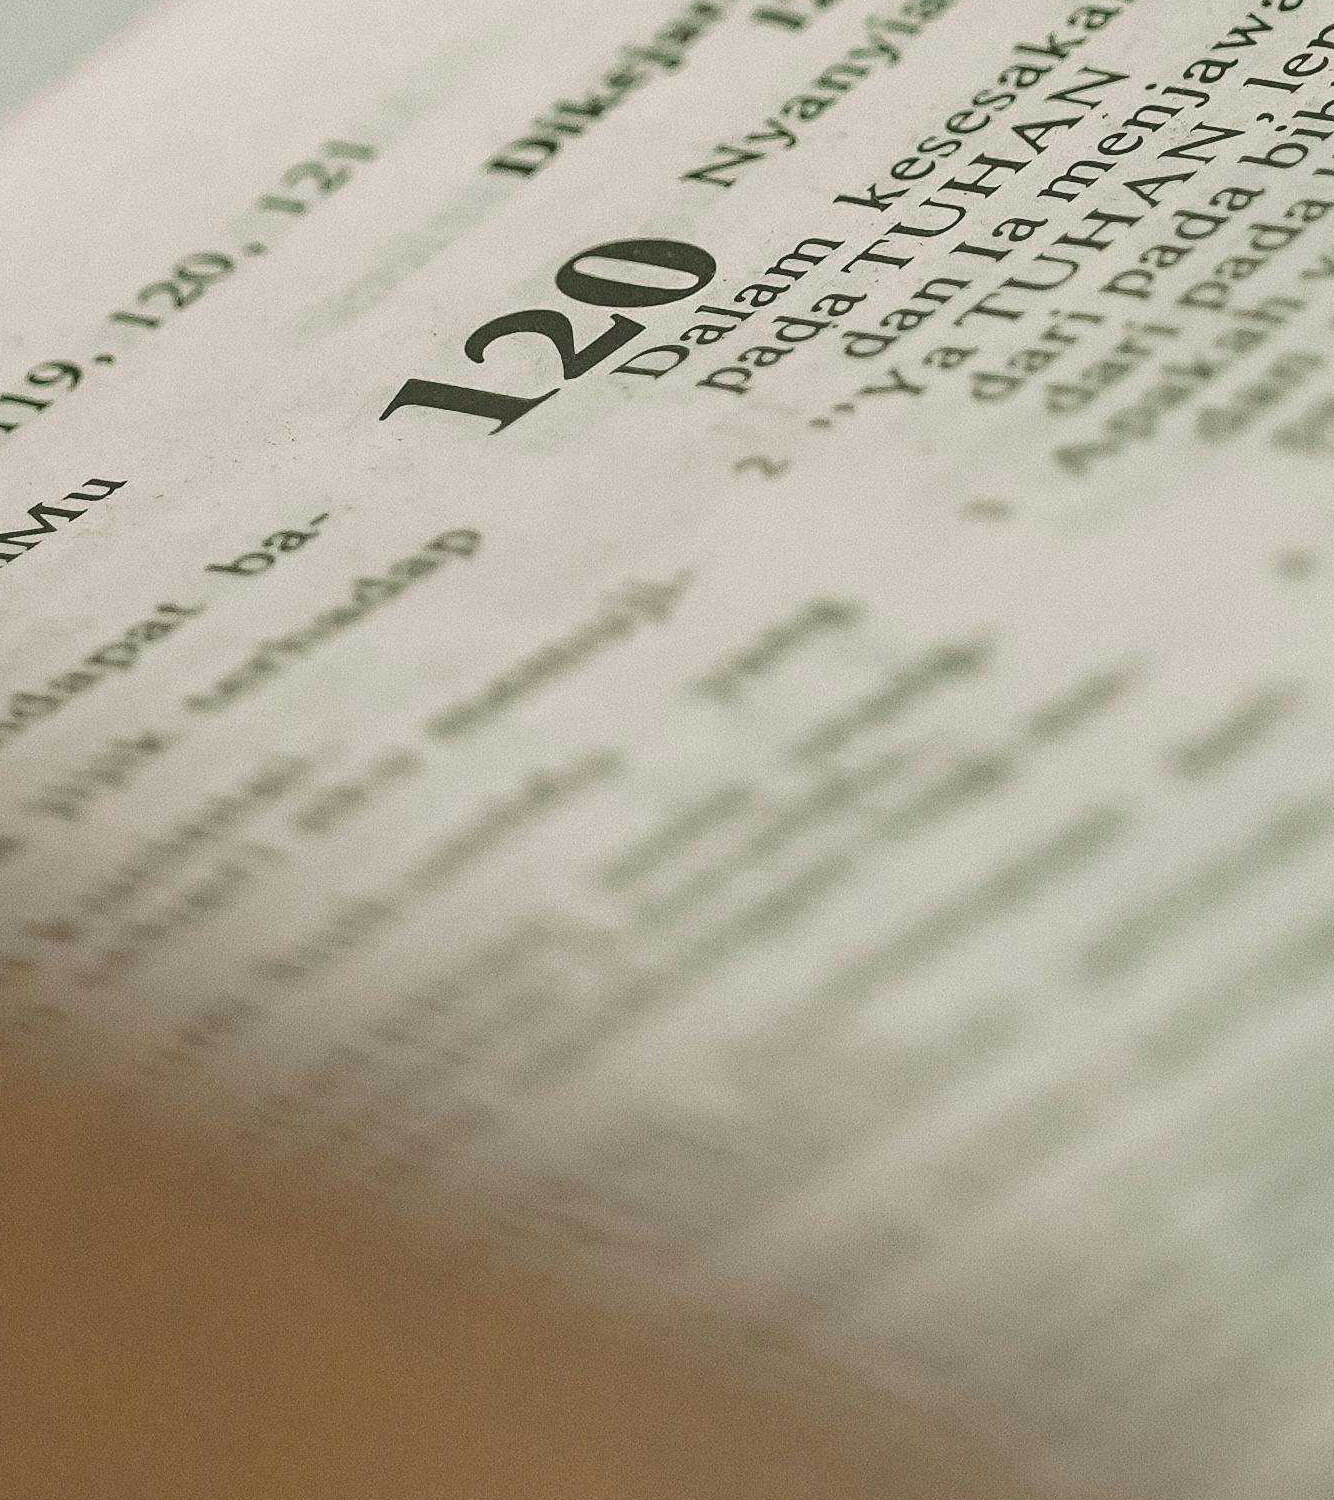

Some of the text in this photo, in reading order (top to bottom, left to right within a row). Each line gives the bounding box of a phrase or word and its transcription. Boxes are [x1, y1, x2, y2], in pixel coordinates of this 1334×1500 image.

[108, 244, 268, 332] 120,
[256, 139, 379, 219] 121
[609, 236, 845, 381] Dalam
[695, 65, 1131, 394] pada TUHAN
[840, 275, 972, 353] dan
[949, 216, 1048, 264] Ia
[968, 307, 1107, 402] dari
[1099, 186, 1268, 294] pada
[377, 244, 719, 437] 120
[204, 511, 329, 579] ba-
